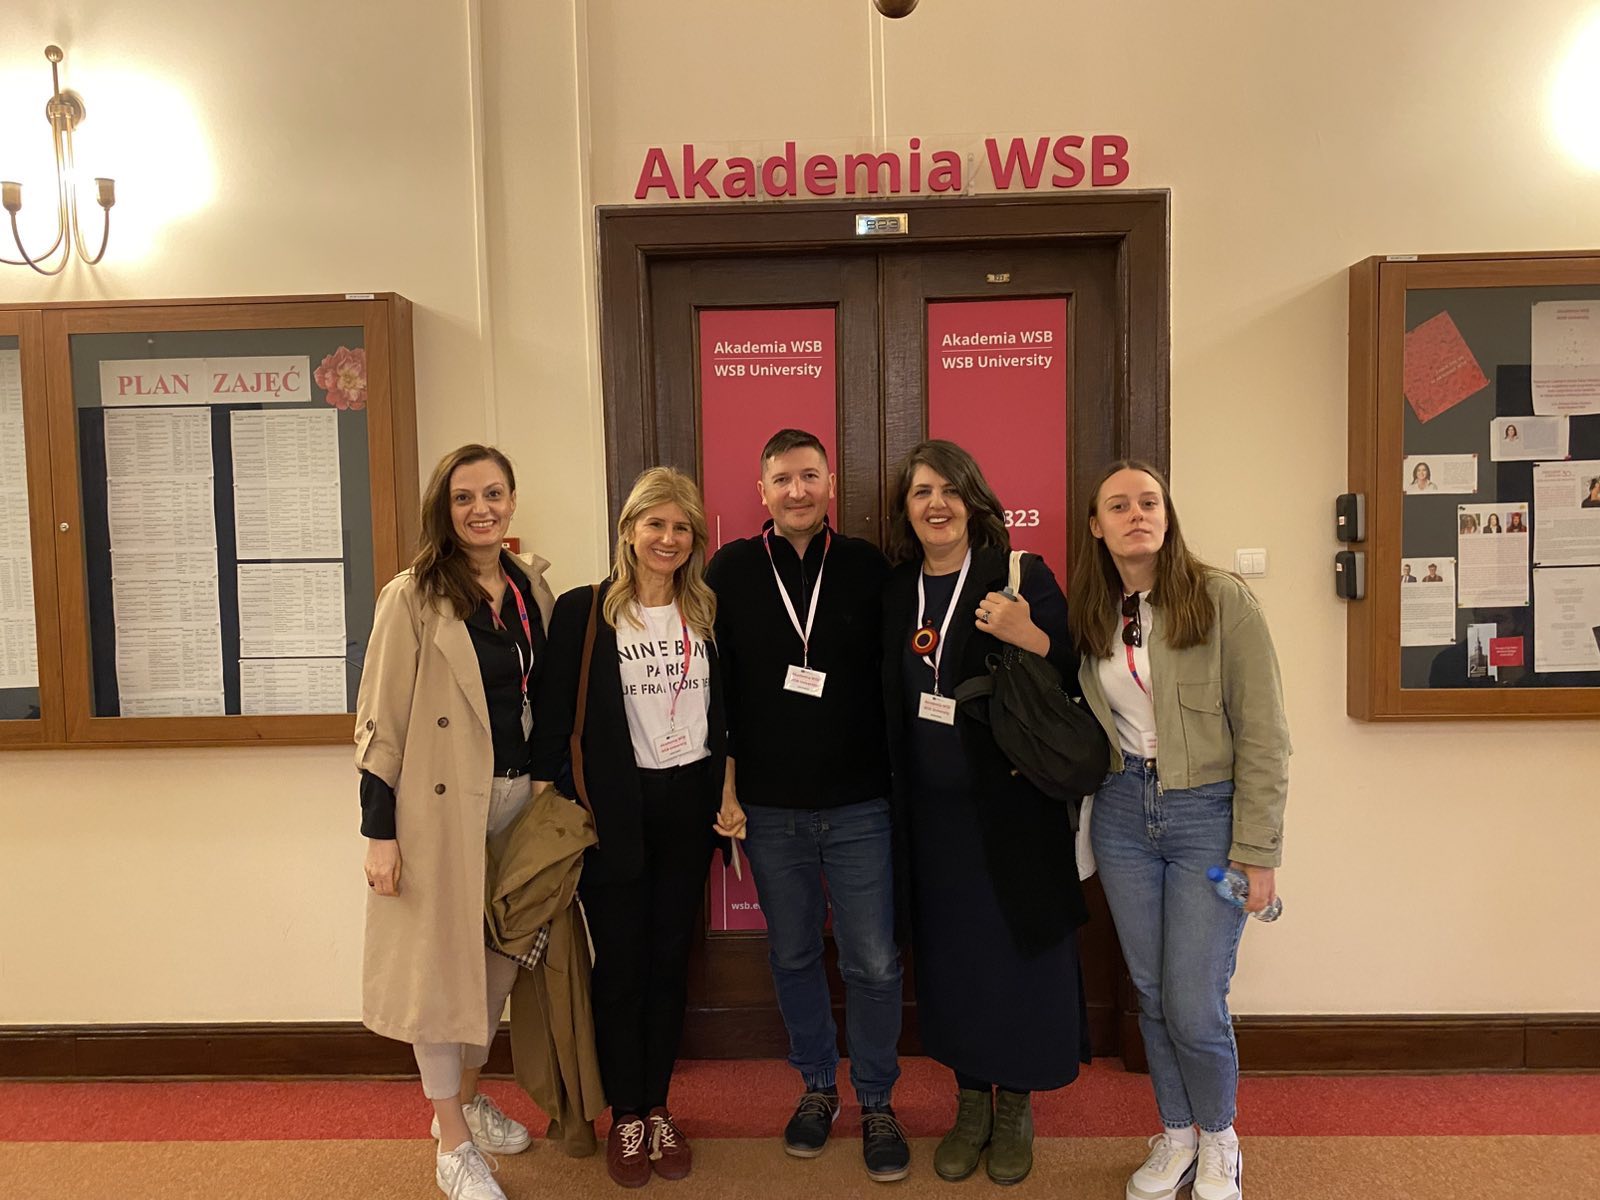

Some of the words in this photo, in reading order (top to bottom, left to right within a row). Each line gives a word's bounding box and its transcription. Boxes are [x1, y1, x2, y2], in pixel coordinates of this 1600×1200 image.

[634, 137, 962, 199] Akademia
[984, 135, 1130, 189] WSB
[942, 331, 1016, 347] Akademia
[1020, 330, 1053, 344] WSB
[714, 340, 787, 354] Akademia
[791, 340, 823, 353] WSB
[942, 356, 974, 369] WSB
[977, 354, 1053, 369] University
[714, 364, 746, 377] WSB
[749, 363, 822, 379] University
[117, 373, 190, 396] PLAN
[213, 366, 301, 398] ZAJĘĆ
